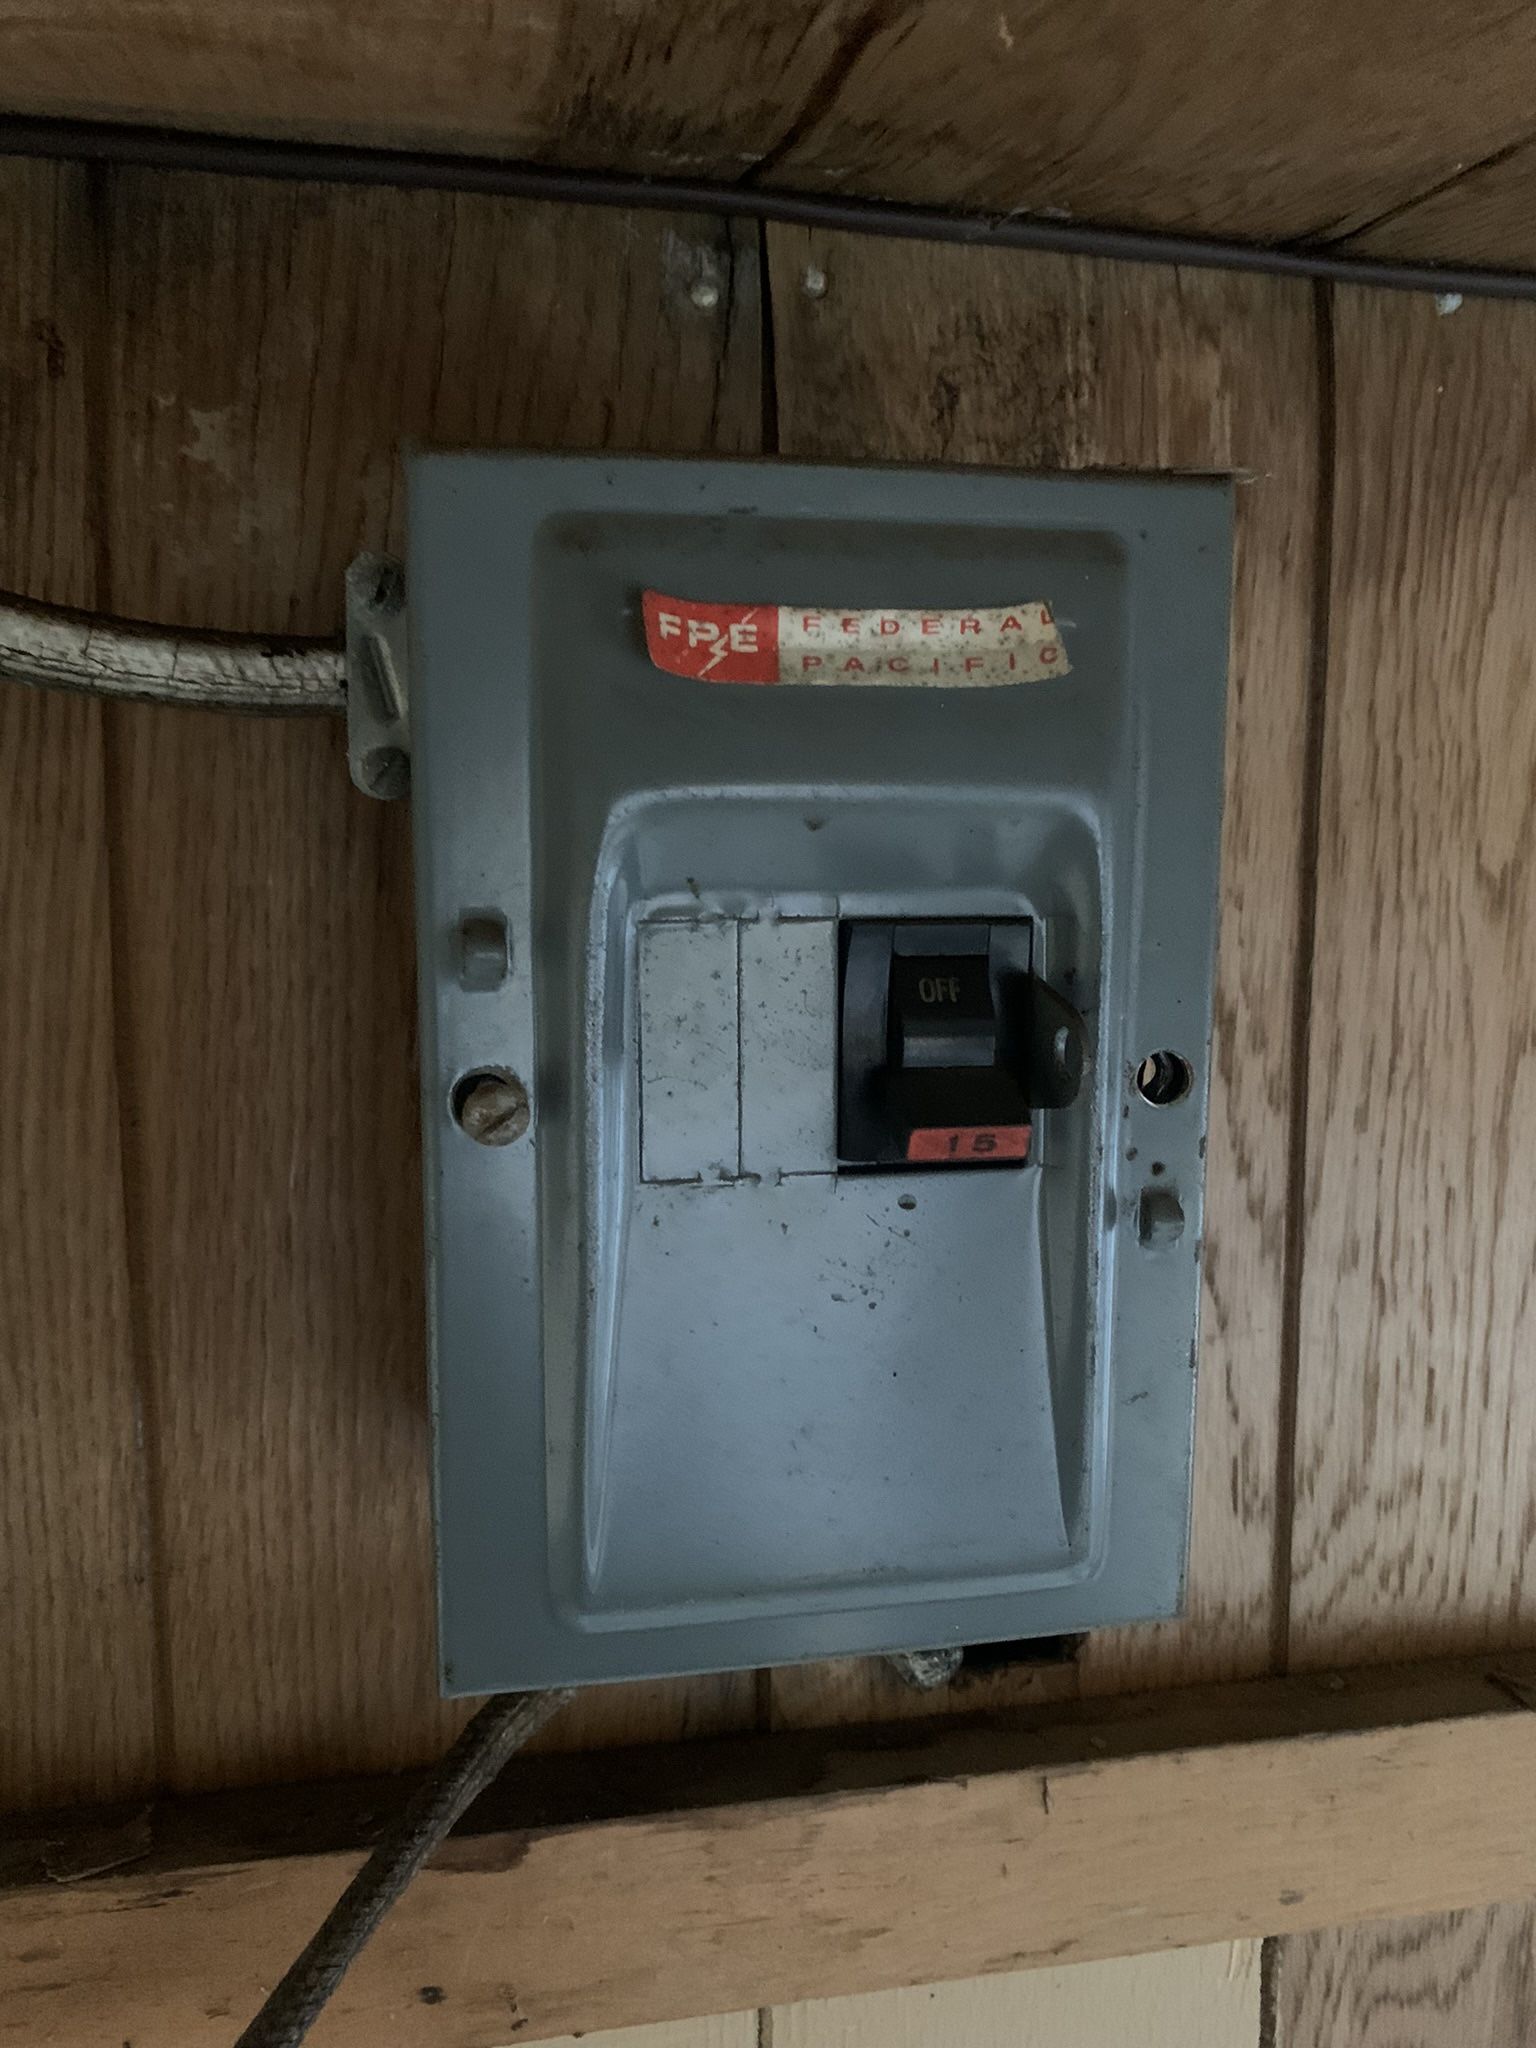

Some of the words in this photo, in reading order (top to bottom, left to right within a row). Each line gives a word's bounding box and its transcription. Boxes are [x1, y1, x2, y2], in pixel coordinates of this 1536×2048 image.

[658, 611, 759, 654] FPE
[802, 609, 1055, 636] FEDERAL
[802, 647, 1059, 675] PACIFIC
[918, 977, 961, 1003] OFF
[948, 1133, 998, 1153] 15
